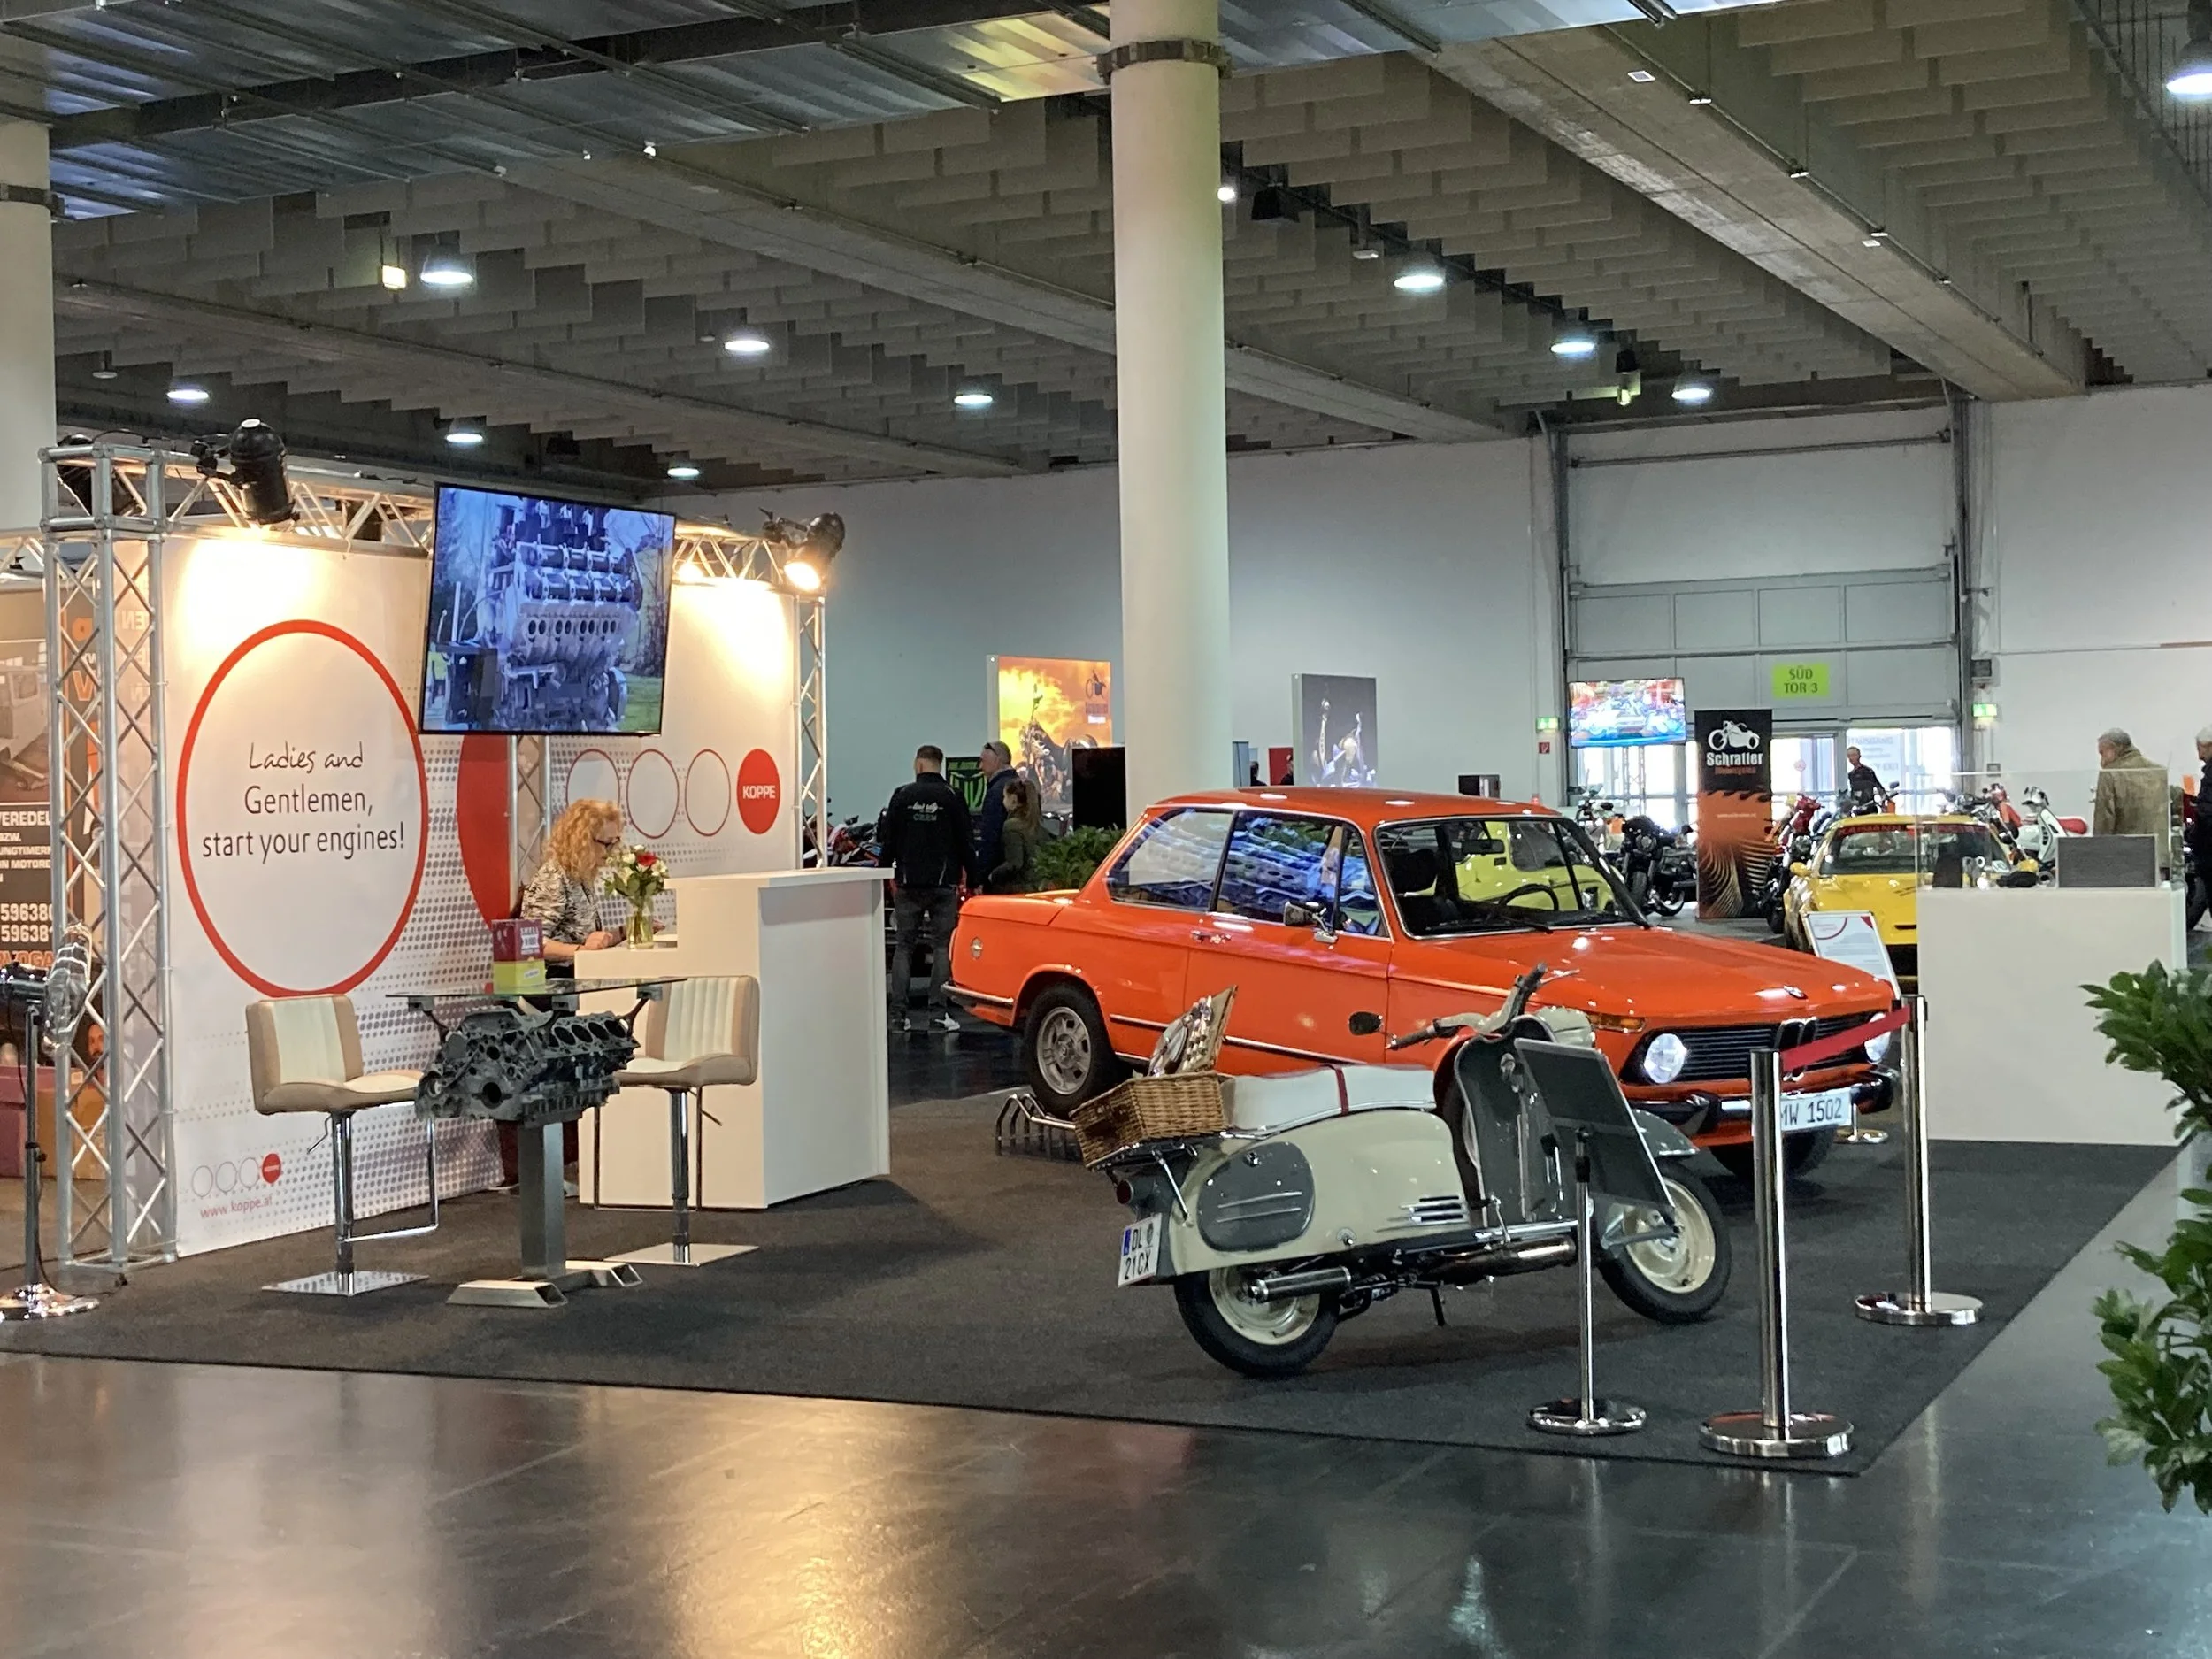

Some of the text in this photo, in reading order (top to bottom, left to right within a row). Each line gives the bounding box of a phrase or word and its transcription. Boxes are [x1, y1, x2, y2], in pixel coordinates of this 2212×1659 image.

[1788, 664, 1814, 680] SÜD
[1783, 682, 1819, 694] TOR 3
[249, 741, 364, 774] Ladies and
[244, 783, 373, 816] Gentlemen,
[742, 785, 776, 800] KOPPE
[203, 821, 404, 864] start your engines!
[1807, 1097, 1843, 1124] 1502
